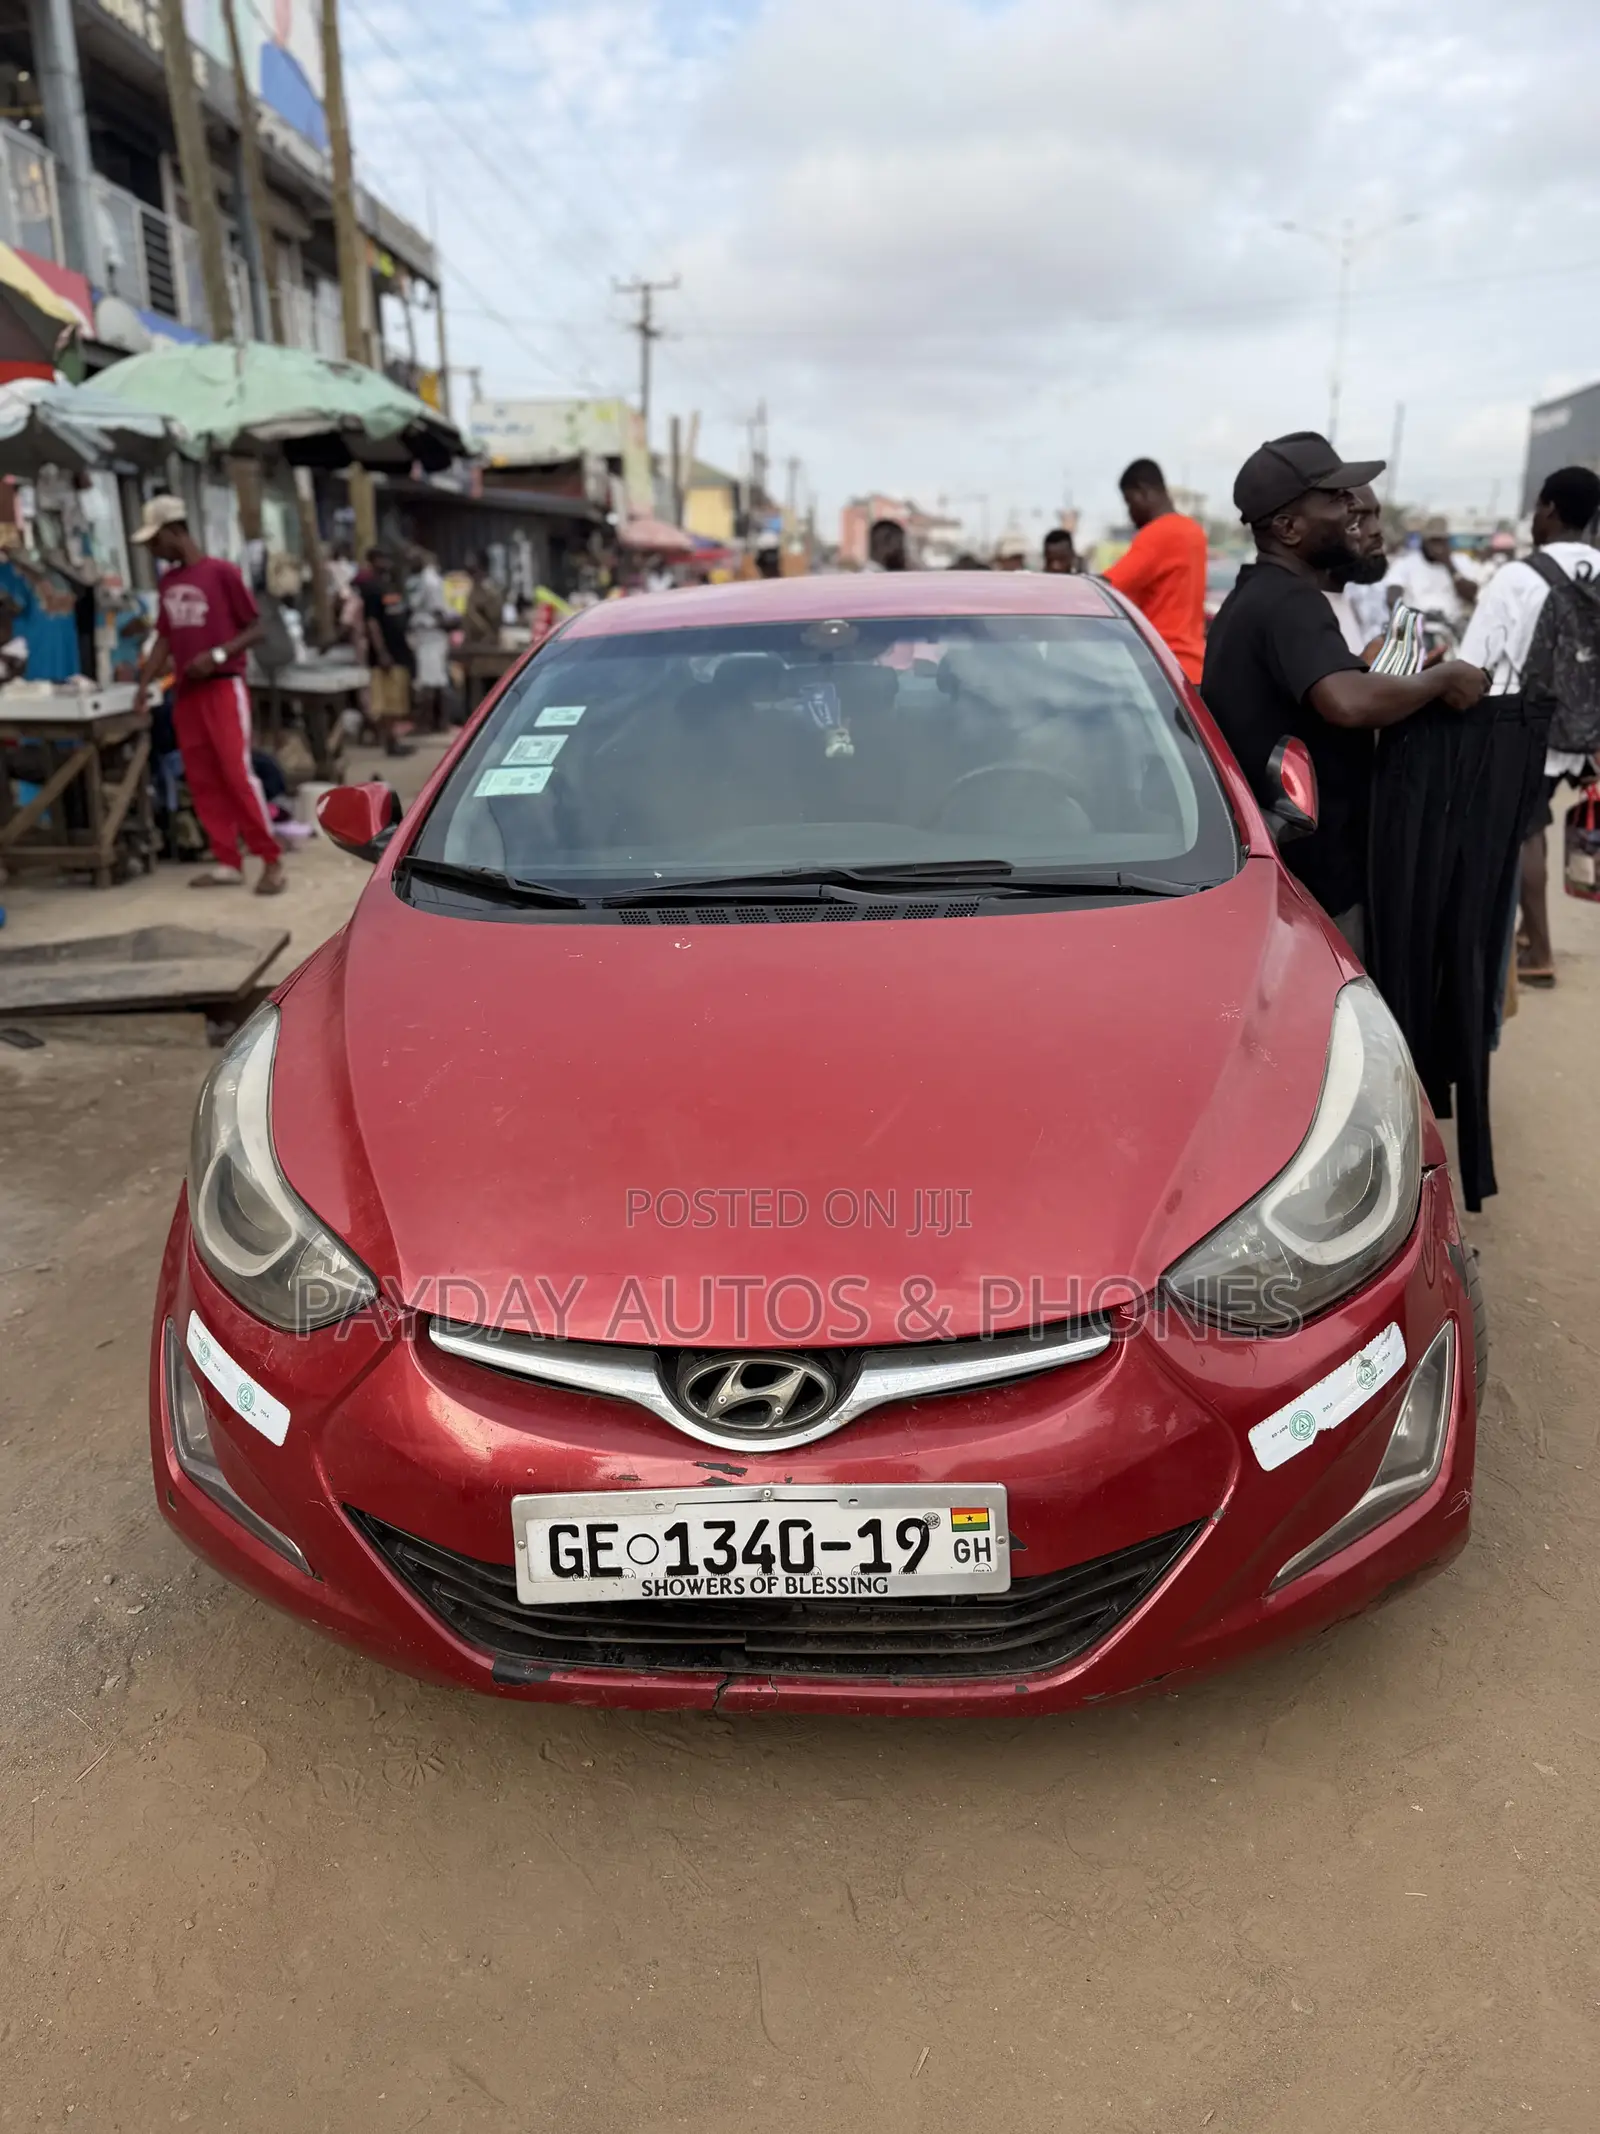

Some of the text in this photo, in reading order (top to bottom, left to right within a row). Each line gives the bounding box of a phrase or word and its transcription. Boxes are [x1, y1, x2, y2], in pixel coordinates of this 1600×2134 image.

[548, 1518, 931, 1577] GE 1340-19
[953, 1537, 992, 1564] GH
[641, 1576, 889, 1597] SHOWERS OF BLESSING
